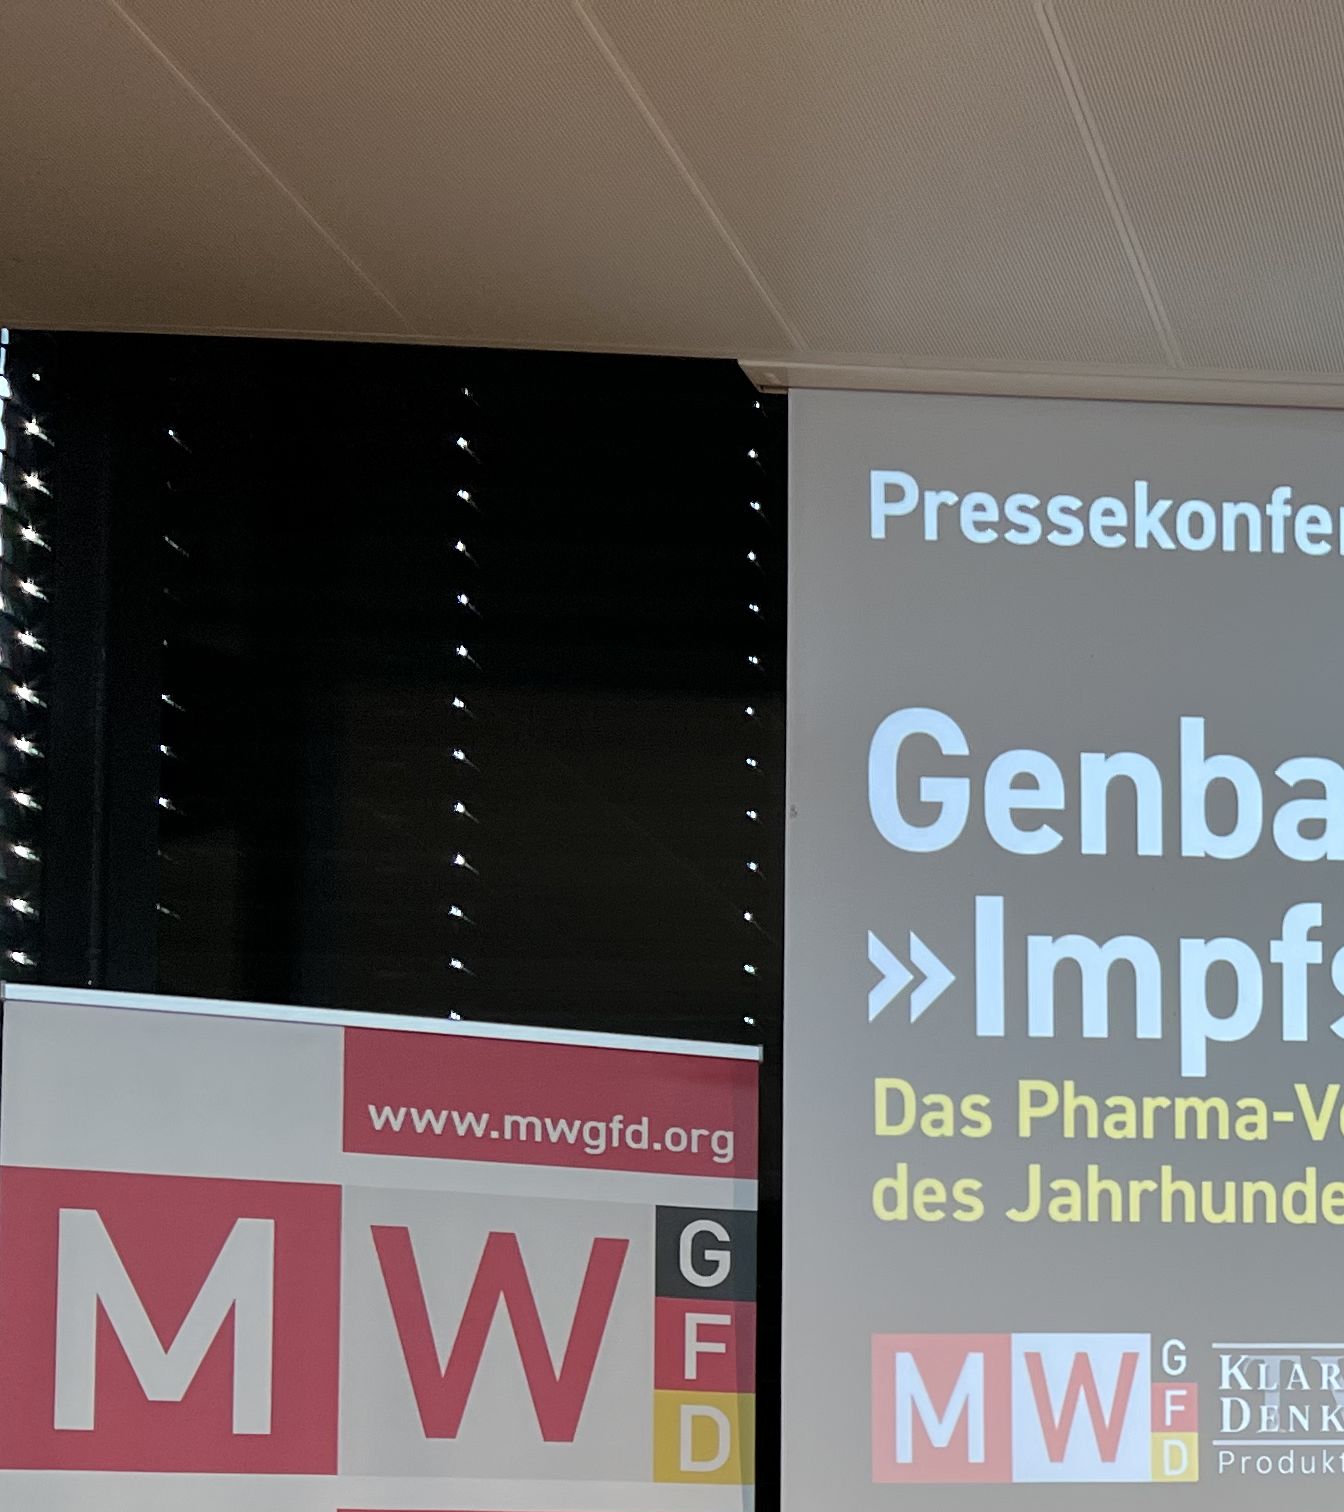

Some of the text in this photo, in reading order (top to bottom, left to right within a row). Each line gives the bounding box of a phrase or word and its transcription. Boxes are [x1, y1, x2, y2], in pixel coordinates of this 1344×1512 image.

[367, 1104, 735, 1163] www.mwgfd.org
[874, 1077, 993, 1138] Das
[873, 1162, 985, 1222] des
